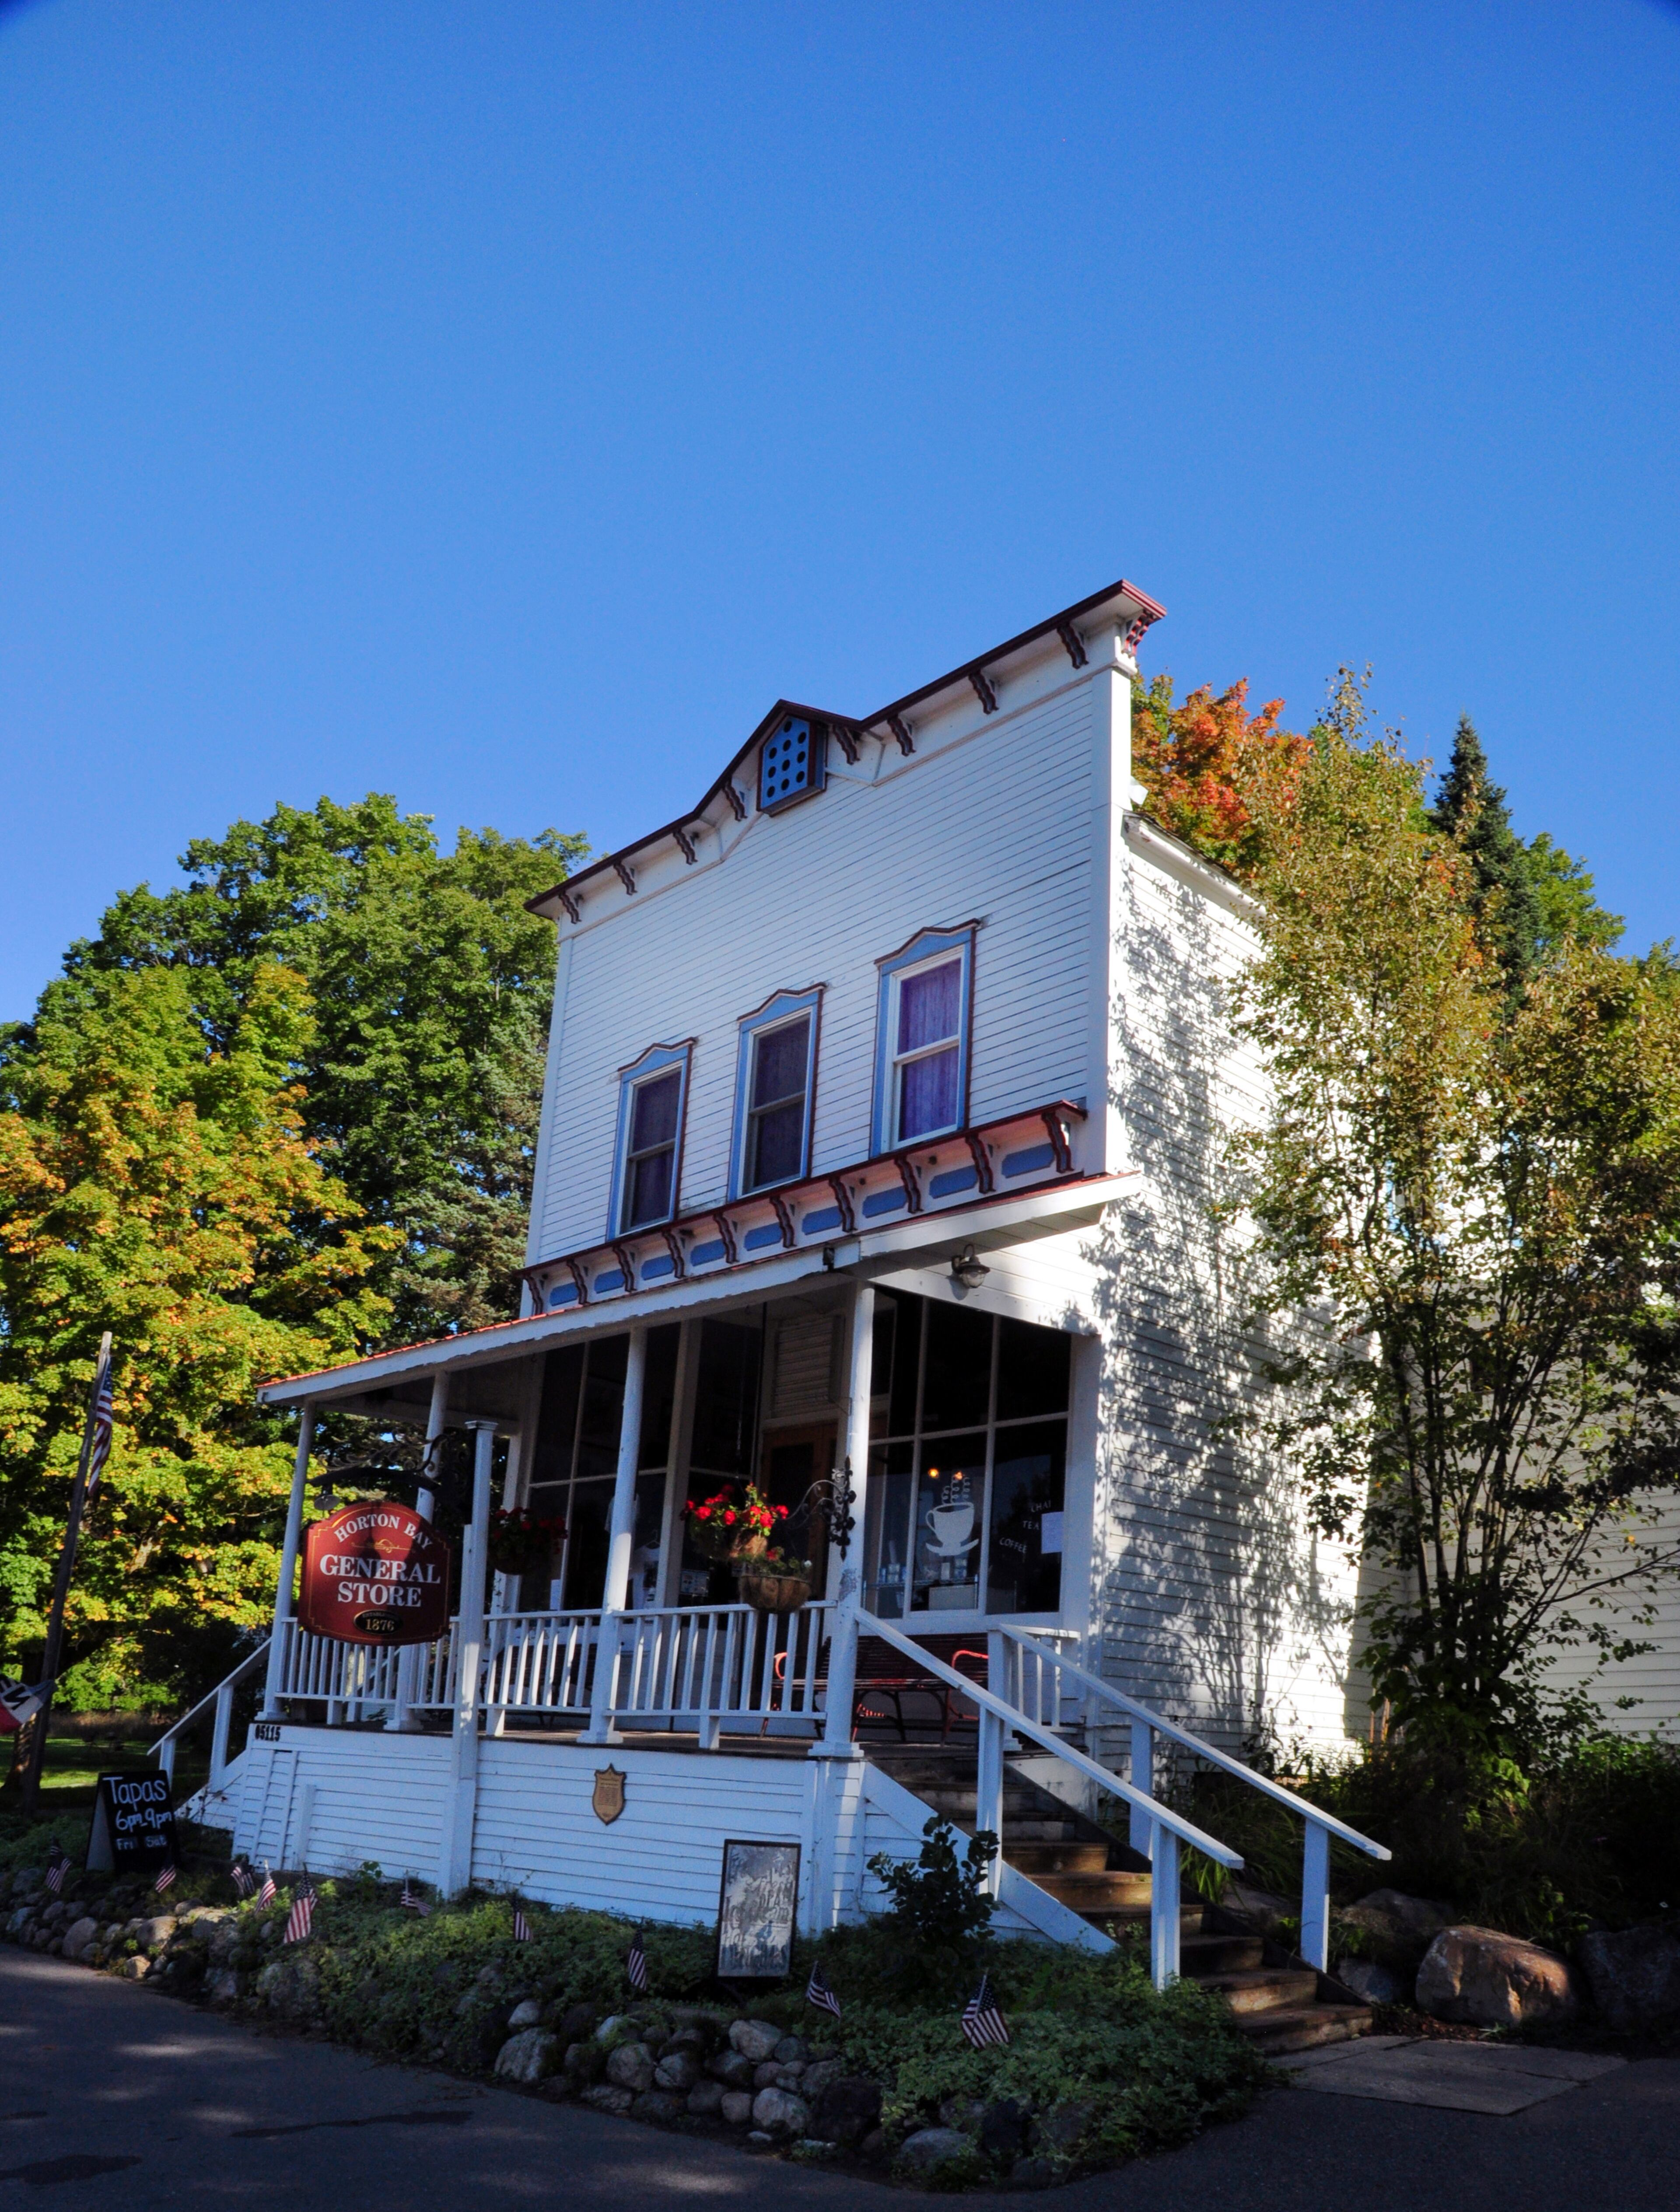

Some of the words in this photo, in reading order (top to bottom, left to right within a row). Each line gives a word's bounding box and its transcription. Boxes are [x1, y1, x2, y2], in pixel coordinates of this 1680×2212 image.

[334, 1514, 400, 1542] HORTON
[404, 1522, 432, 1549] BAY
[1023, 1520, 1039, 1530] TEA
[999, 1537, 1028, 1553] COFFEE
[320, 1554, 440, 1584] GENERAL
[337, 1581, 421, 1607] STORE
[365, 1618, 395, 1631] 1876
[102, 1776, 167, 1812] Tapas
[116, 1838, 134, 1850] Fri
[145, 1835, 167, 1847] Sat
